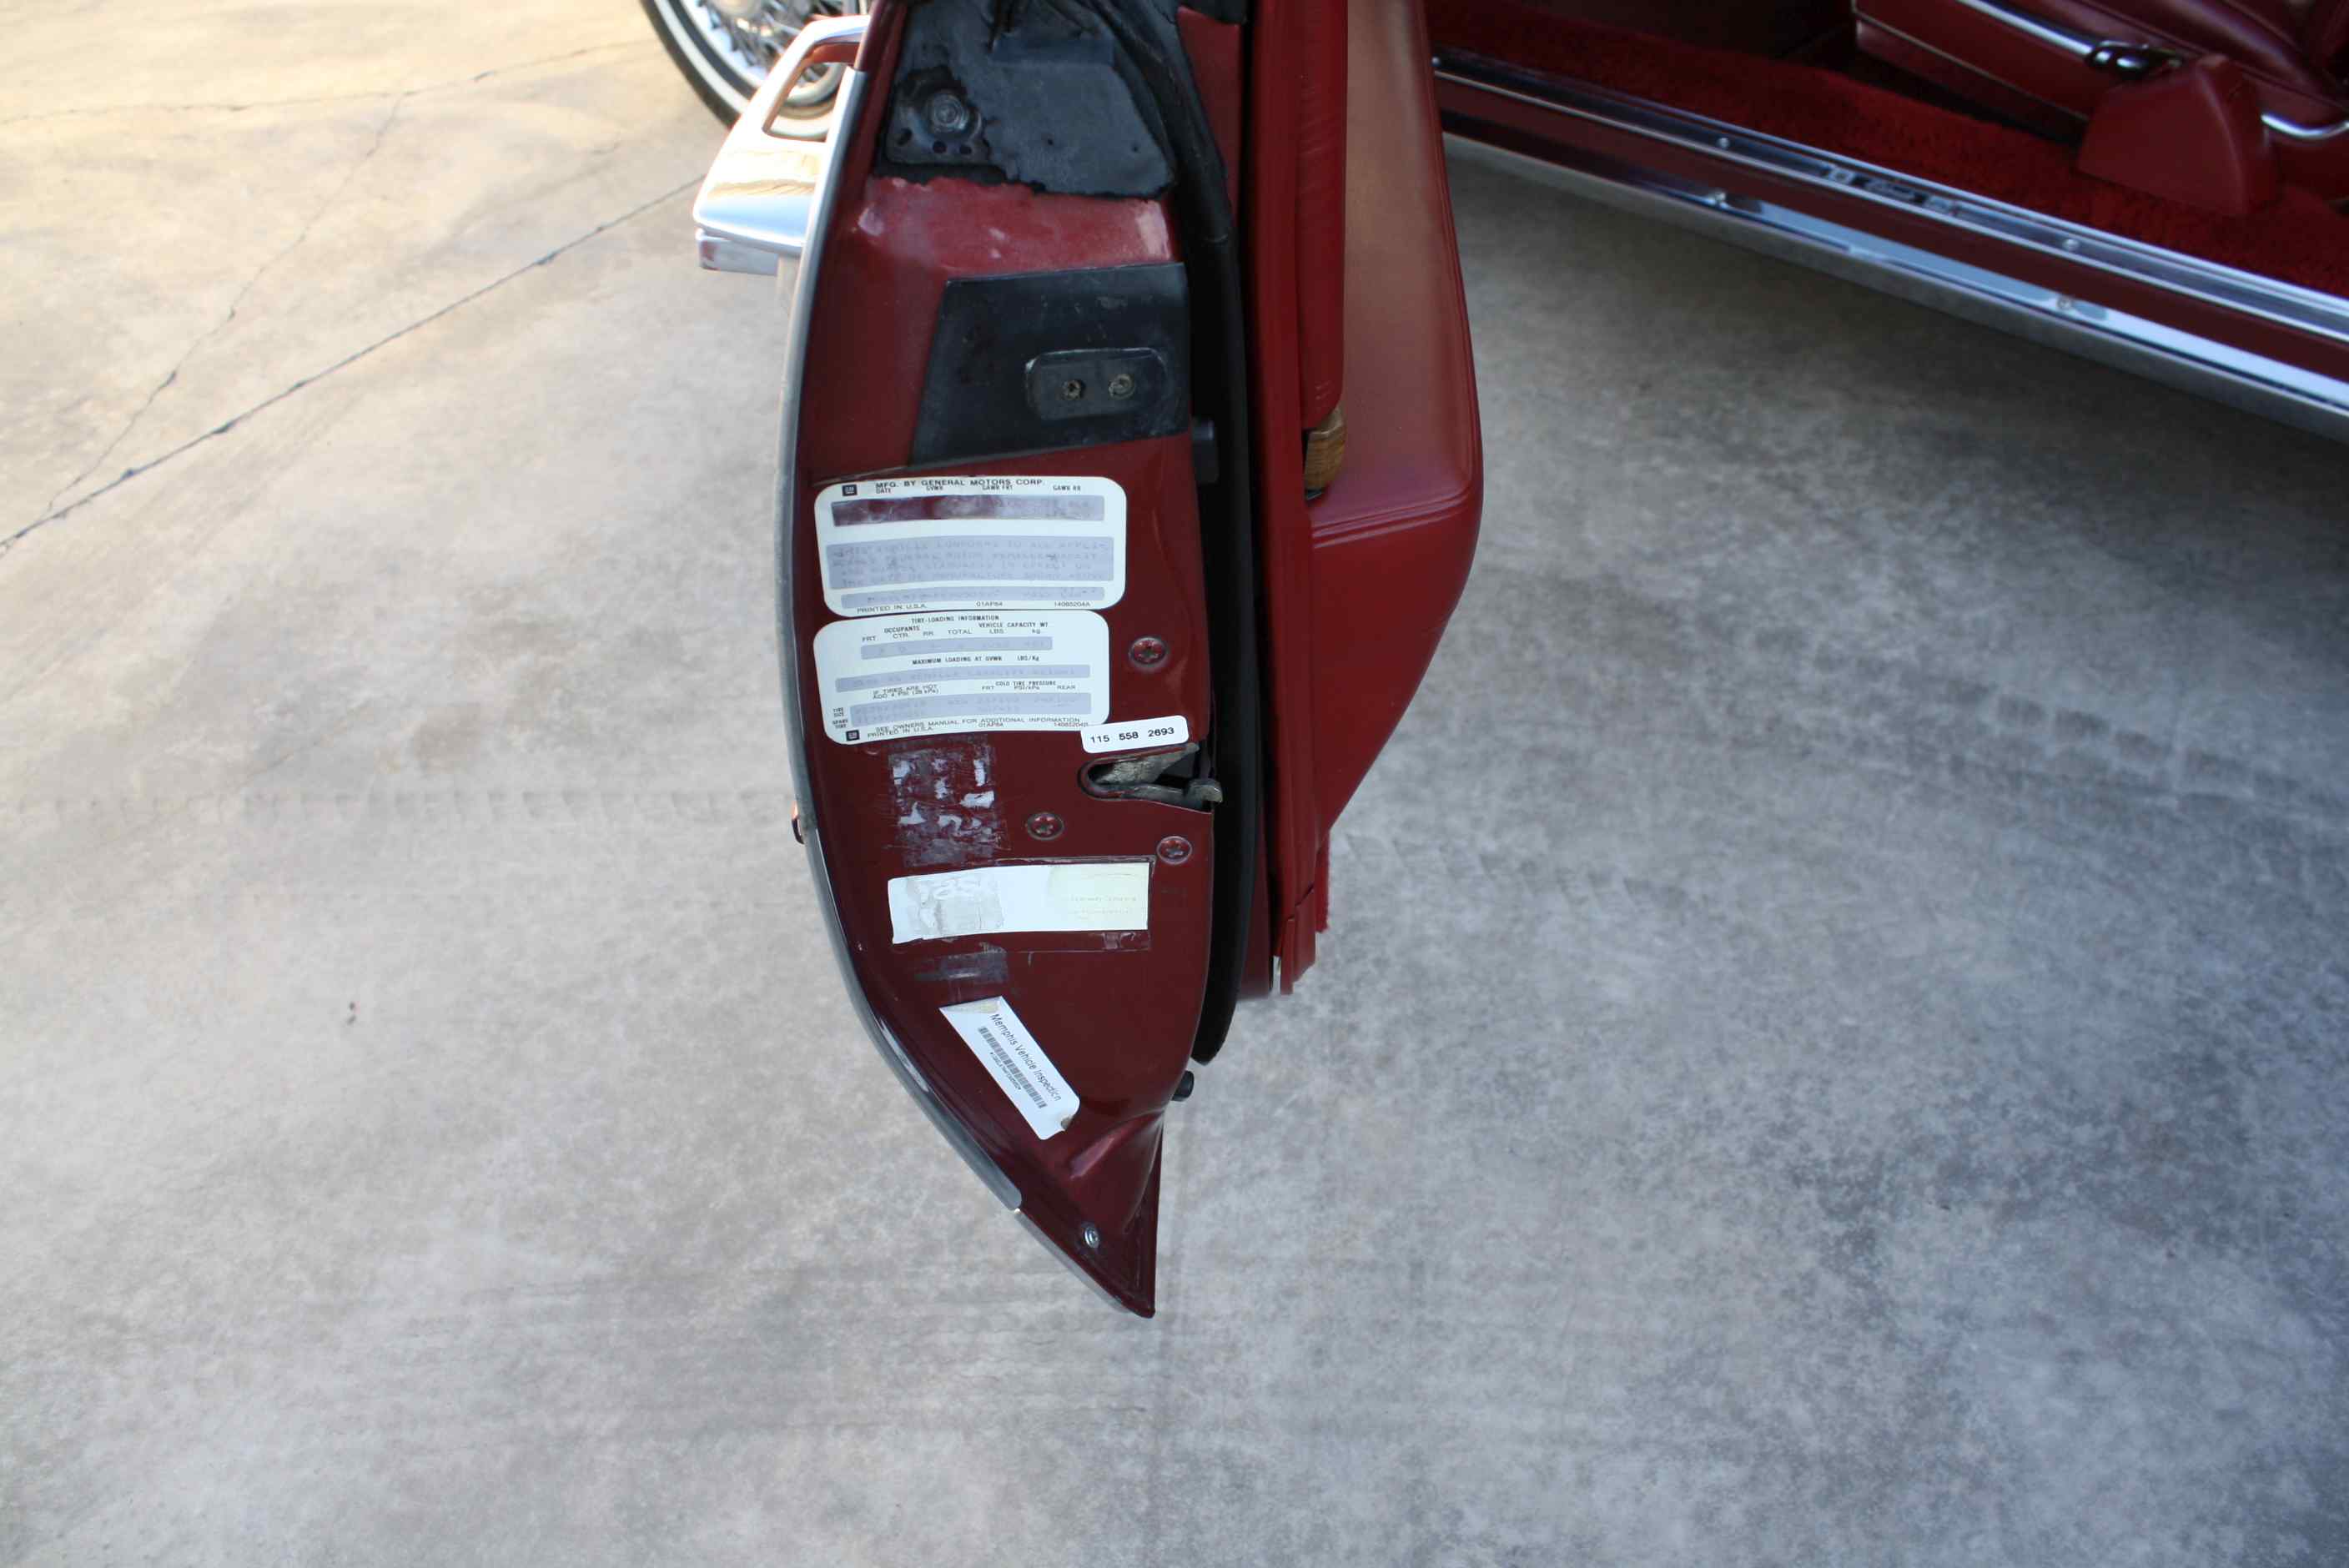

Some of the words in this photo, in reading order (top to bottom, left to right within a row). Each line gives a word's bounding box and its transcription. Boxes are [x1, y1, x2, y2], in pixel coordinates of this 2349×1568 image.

[1119, 731, 1139, 741] 558
[1148, 726, 1174, 737] 2693
[990, 1013, 1019, 1045] Memphis
[1014, 1044, 1038, 1069] Vehicle
[1033, 1069, 1062, 1102] Inspection
